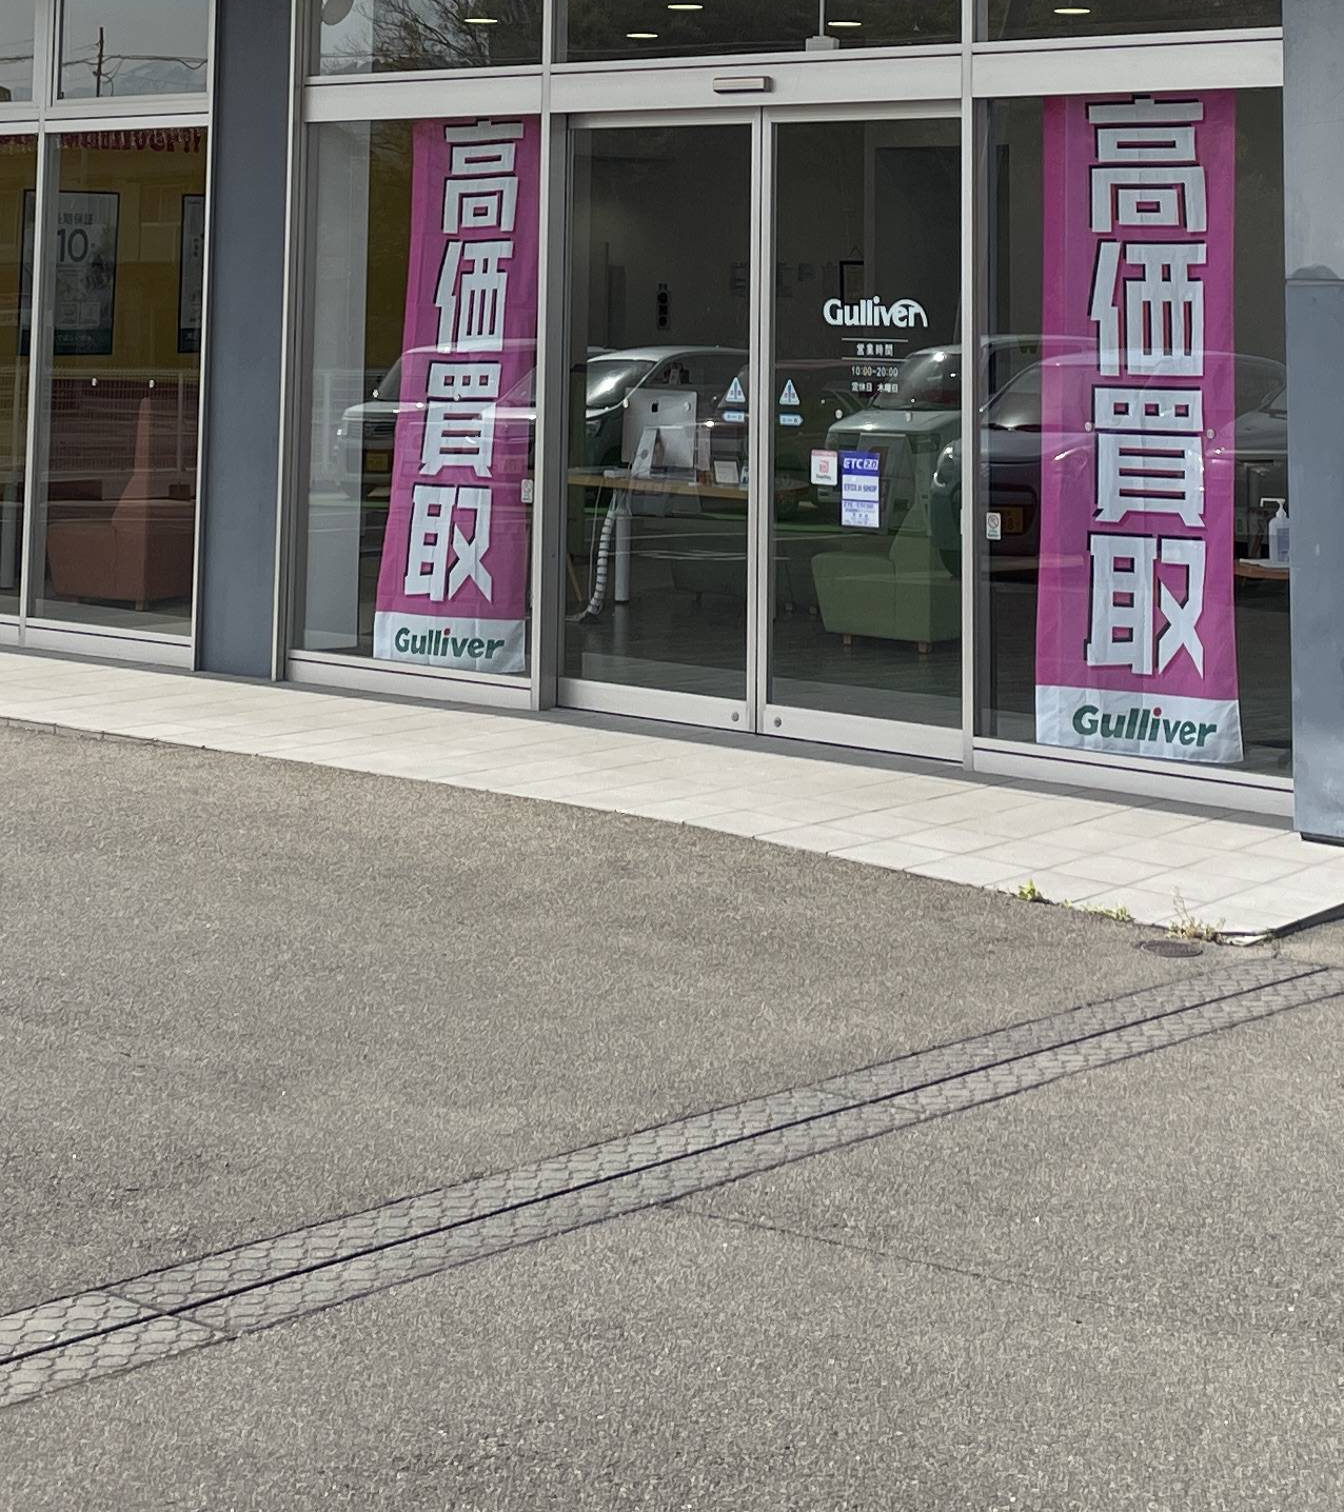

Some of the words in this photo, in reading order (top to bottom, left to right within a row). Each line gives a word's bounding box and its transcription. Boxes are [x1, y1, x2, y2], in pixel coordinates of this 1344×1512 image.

[822, 295, 928, 328] Gulliver
[404, 119, 524, 604] 高価買取
[1083, 95, 1208, 680] 高価買取
[394, 627, 505, 659] Gulliver
[1072, 704, 1217, 747] Gulliver
